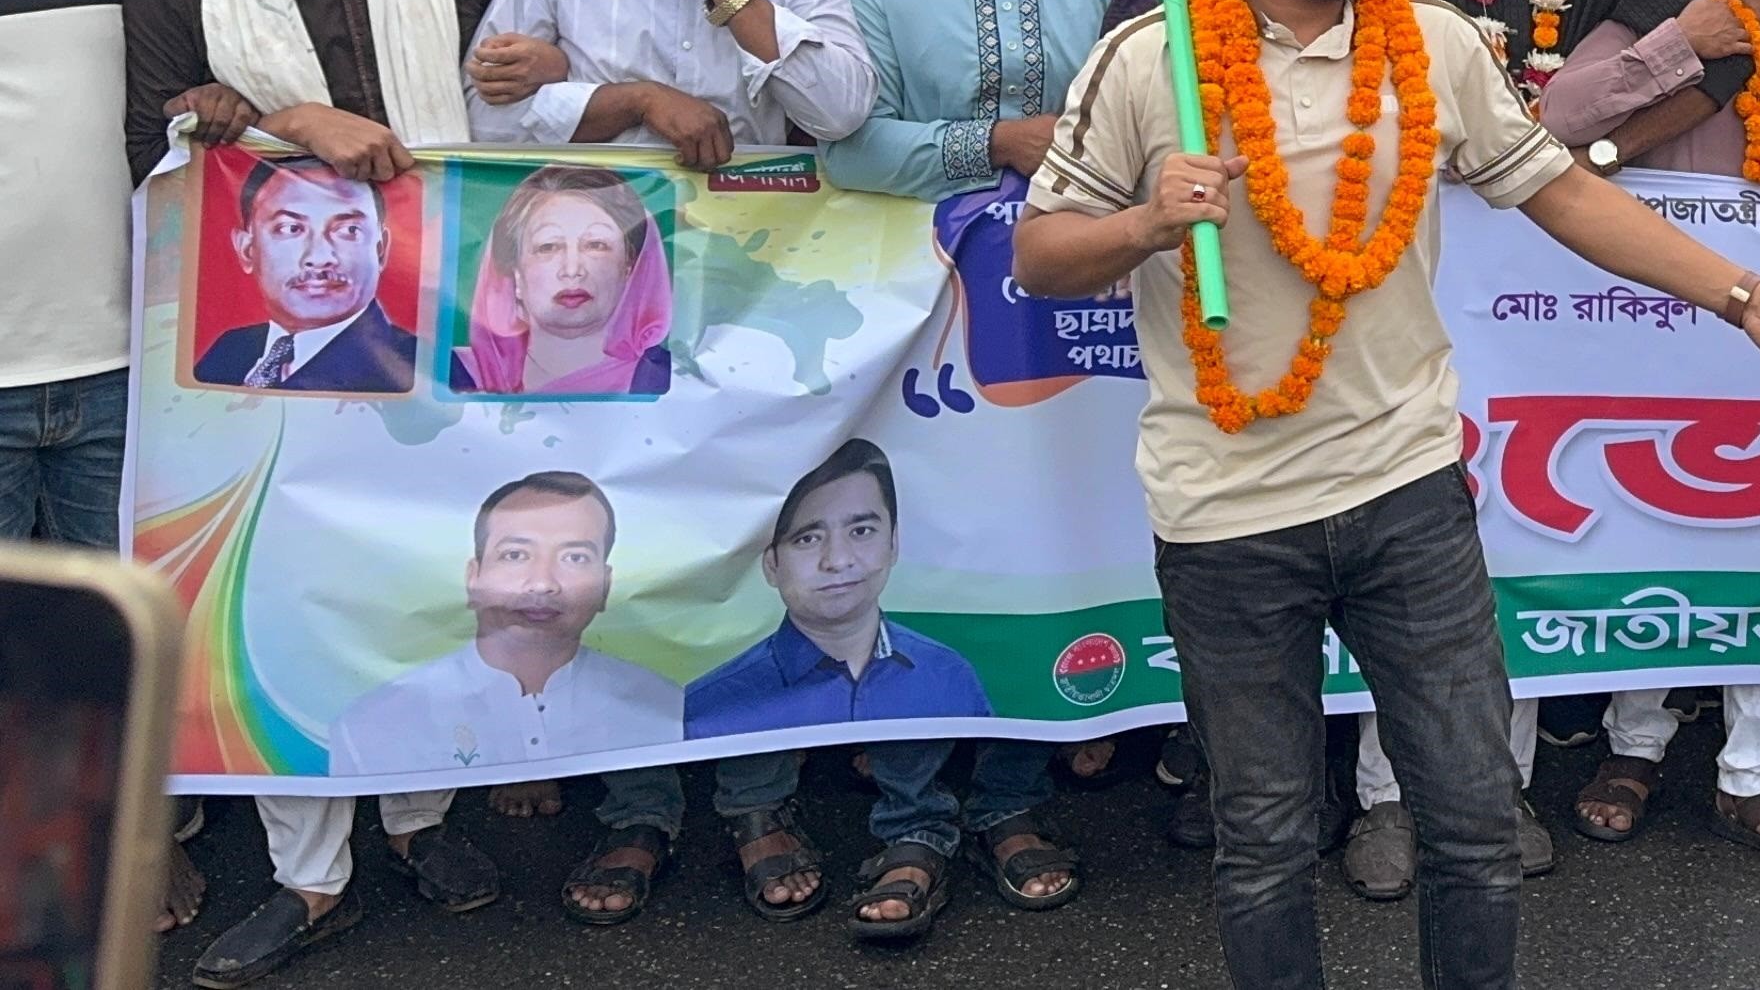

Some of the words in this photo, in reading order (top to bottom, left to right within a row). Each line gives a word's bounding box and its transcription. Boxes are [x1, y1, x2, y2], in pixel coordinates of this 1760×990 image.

[1054, 309, 1137, 339] ছাত্রদ
[1492, 291, 1558, 322] মোঃ
[1570, 286, 1698, 332] রাকিবুল
[1067, 344, 1141, 371] পথচ
